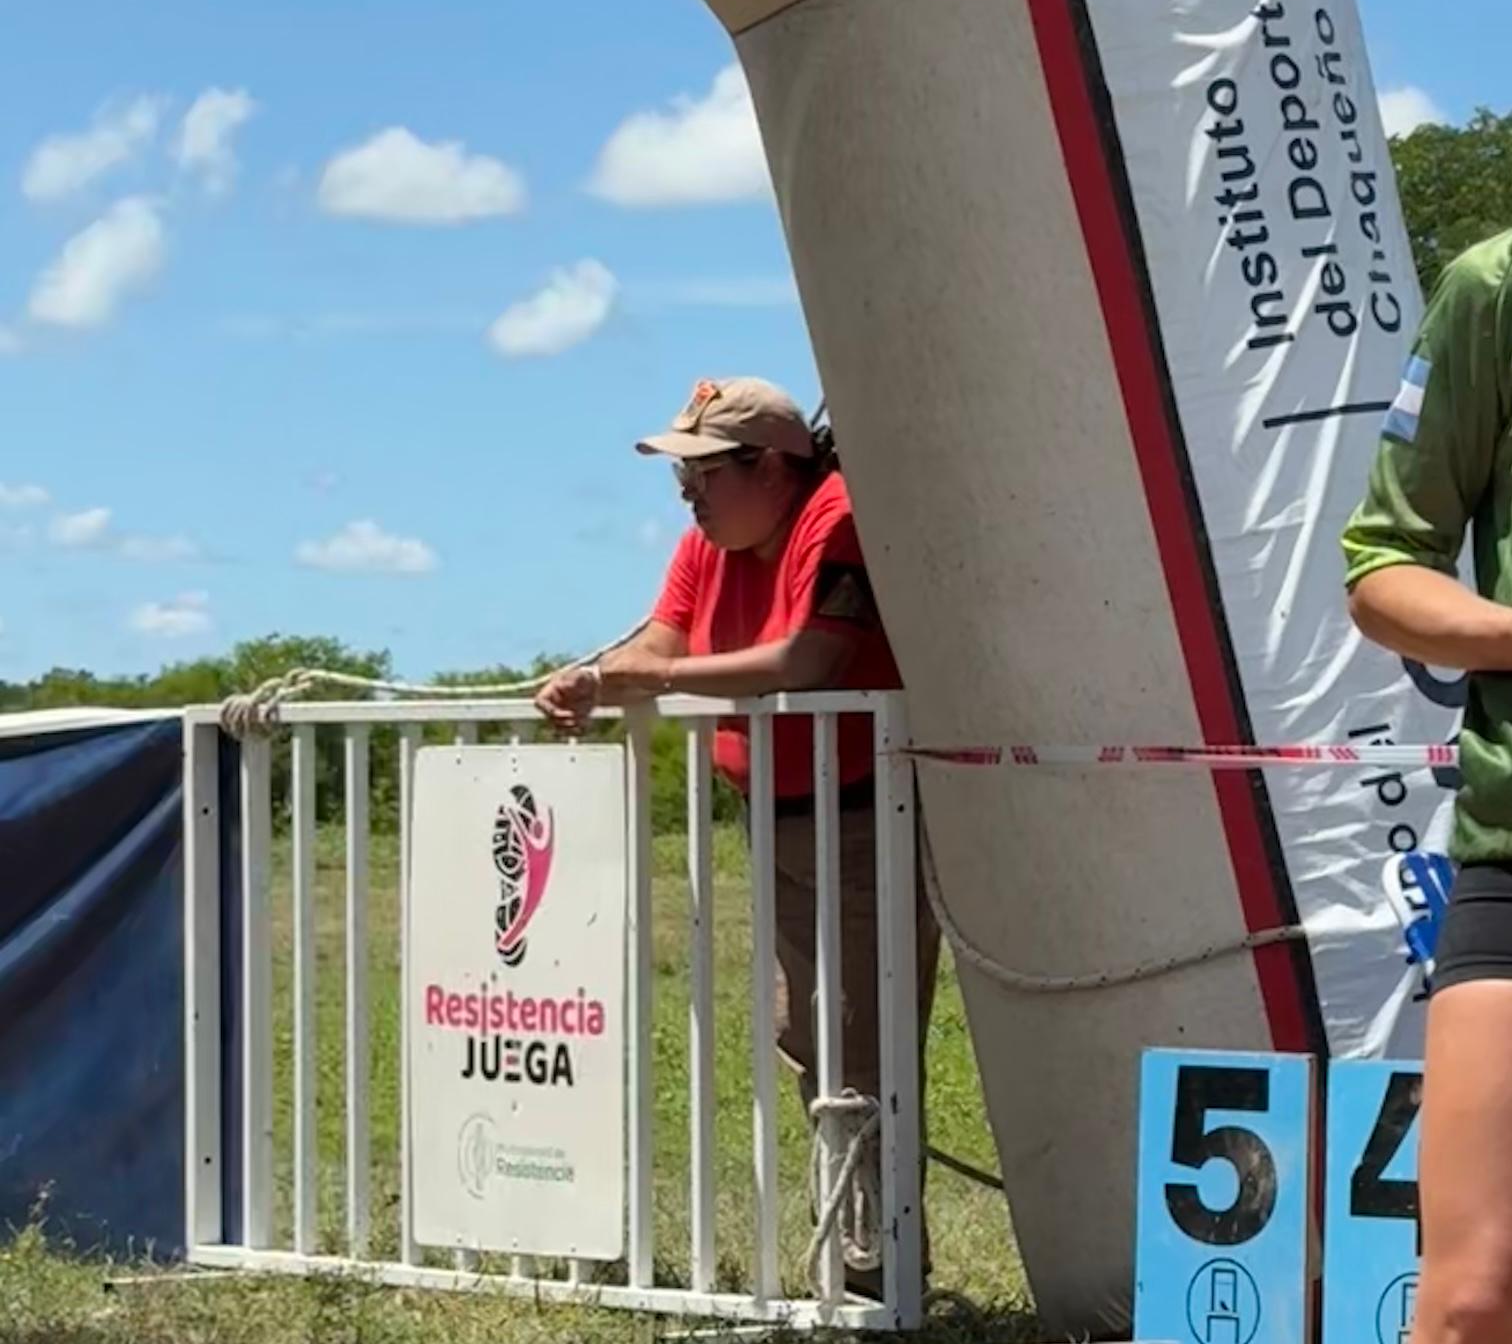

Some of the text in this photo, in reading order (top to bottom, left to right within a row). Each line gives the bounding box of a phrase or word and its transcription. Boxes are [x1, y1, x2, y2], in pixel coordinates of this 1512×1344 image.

[1205, 77, 1295, 349] Instituto
[1302, 244, 1358, 338] del
[425, 983, 605, 1036] Resistencia
[461, 1035, 574, 1087] JUEGA
[1164, 1065, 1277, 1246] 5
